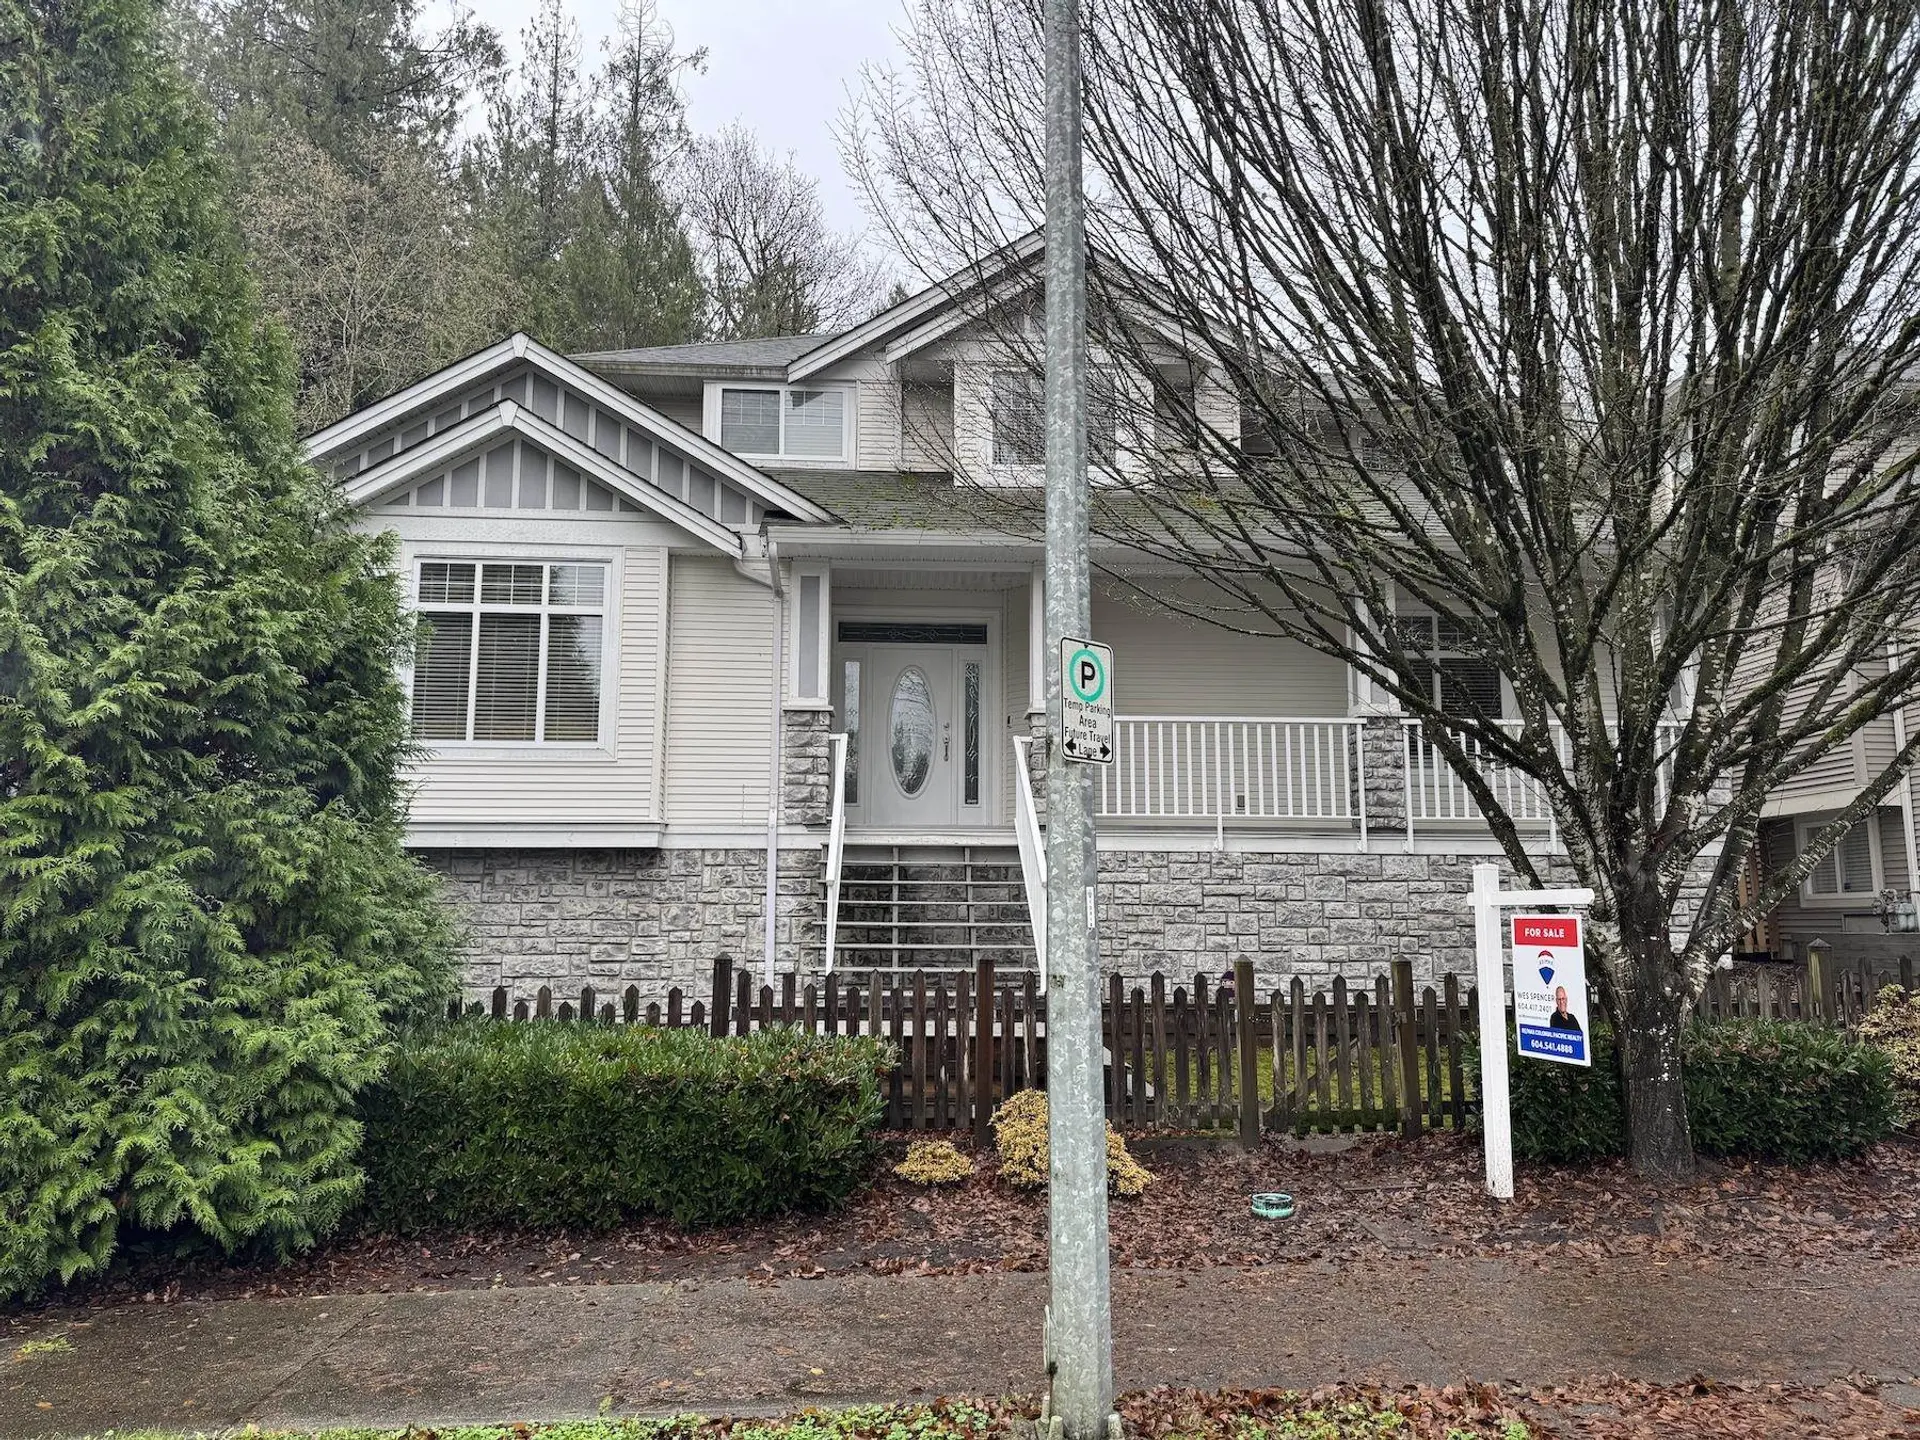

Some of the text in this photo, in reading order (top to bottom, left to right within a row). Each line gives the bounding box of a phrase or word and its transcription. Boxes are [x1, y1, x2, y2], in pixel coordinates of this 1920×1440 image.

[1081, 661, 1095, 689] P
[1064, 698, 1110, 719] Temp Parking
[1079, 715, 1097, 729] Area
[1064, 727, 1110, 744] Future Travel
[1079, 744, 1097, 757] Lane
[1525, 927, 1564, 938] FOR SALE
